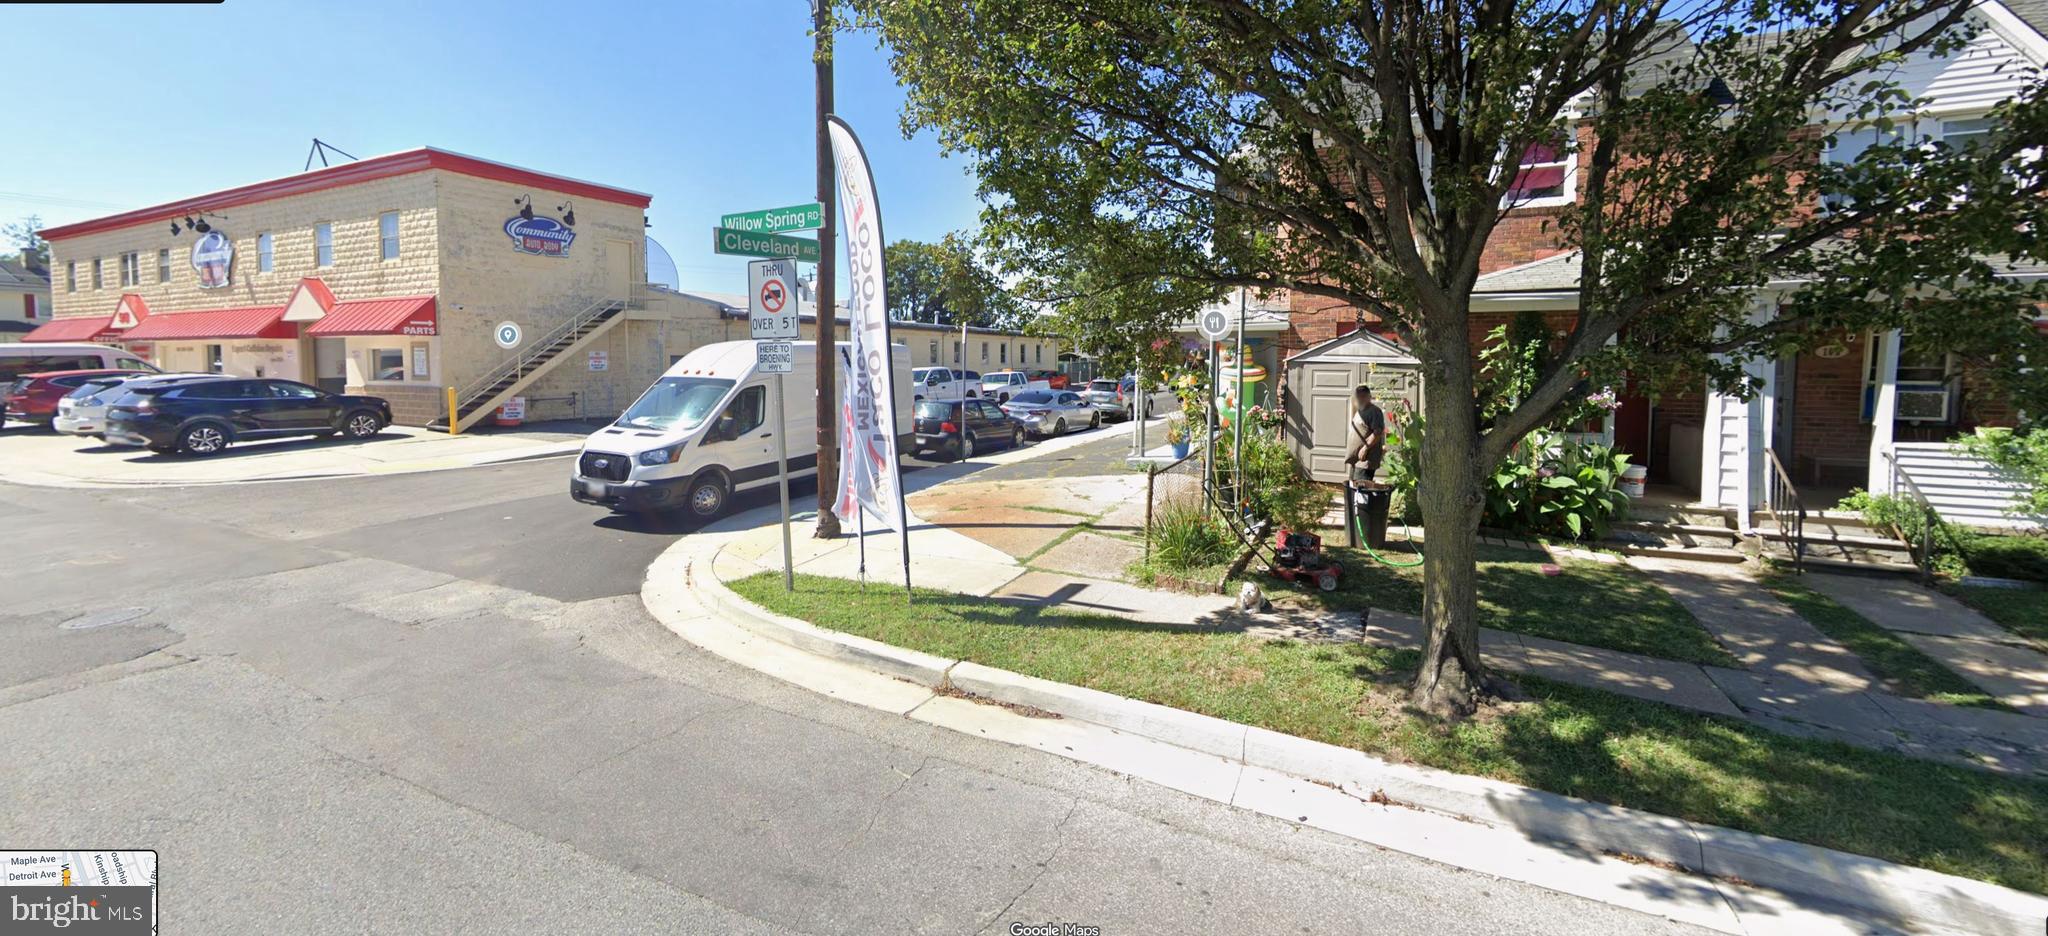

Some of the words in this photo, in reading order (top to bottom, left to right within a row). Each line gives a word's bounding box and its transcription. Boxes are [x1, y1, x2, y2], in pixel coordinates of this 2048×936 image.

[724, 216, 763, 231] Willow
[765, 210, 806, 230] Spring
[807, 210, 819, 221] RD
[506, 216, 574, 246] Community
[723, 233, 800, 256] Cleveland
[803, 245, 817, 255] AVE
[761, 263, 784, 277] THRU
[403, 326, 436, 335] PARTS
[752, 317, 774, 331] OVER
[760, 345, 778, 353] HERE
[780, 344, 790, 353] TO
[759, 353, 791, 364] BROENING
